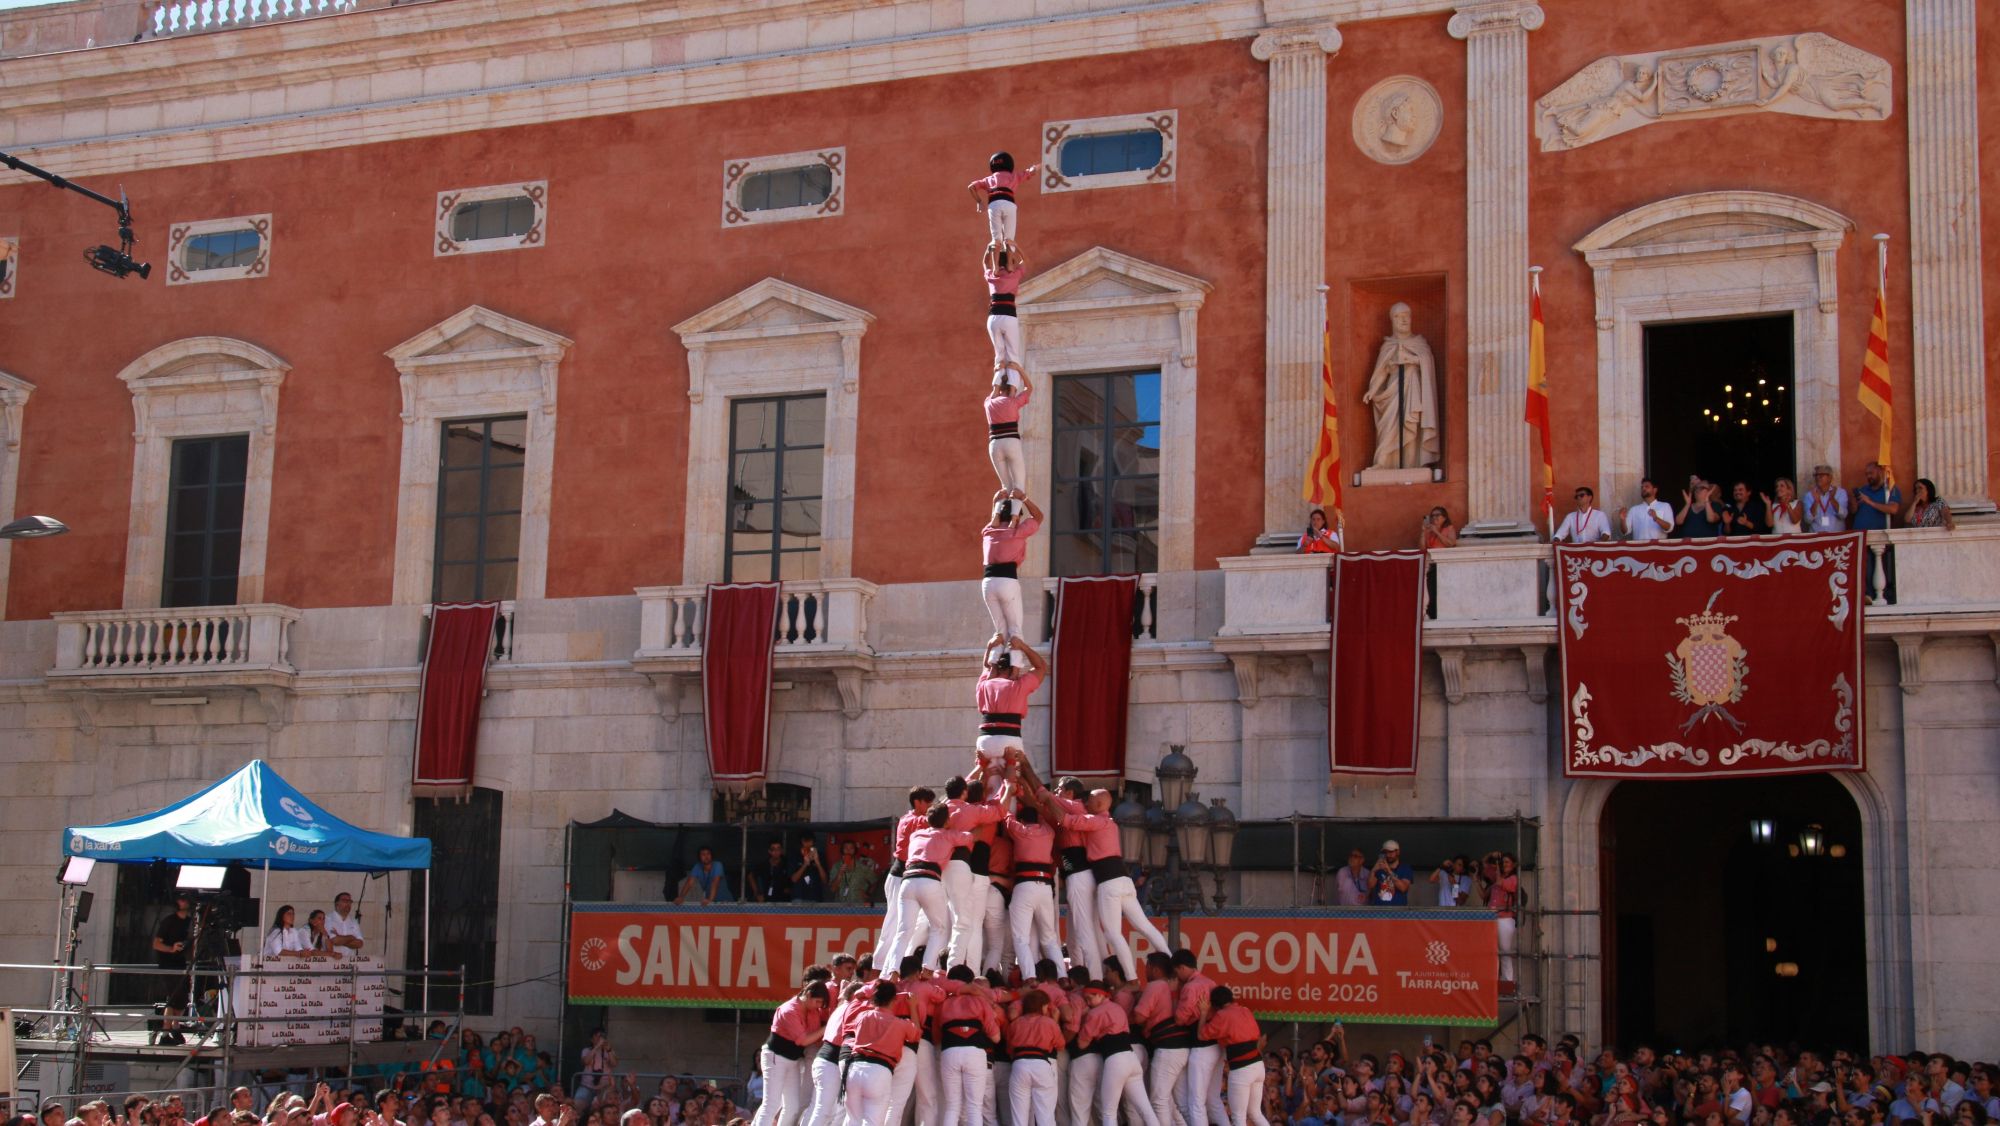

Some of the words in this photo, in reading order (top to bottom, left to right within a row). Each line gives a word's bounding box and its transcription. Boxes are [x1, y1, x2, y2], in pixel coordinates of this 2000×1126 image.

[616, 924, 770, 988] SANTA
[1297, 983, 1322, 1001] de
[1327, 983, 1379, 1002] 2026
